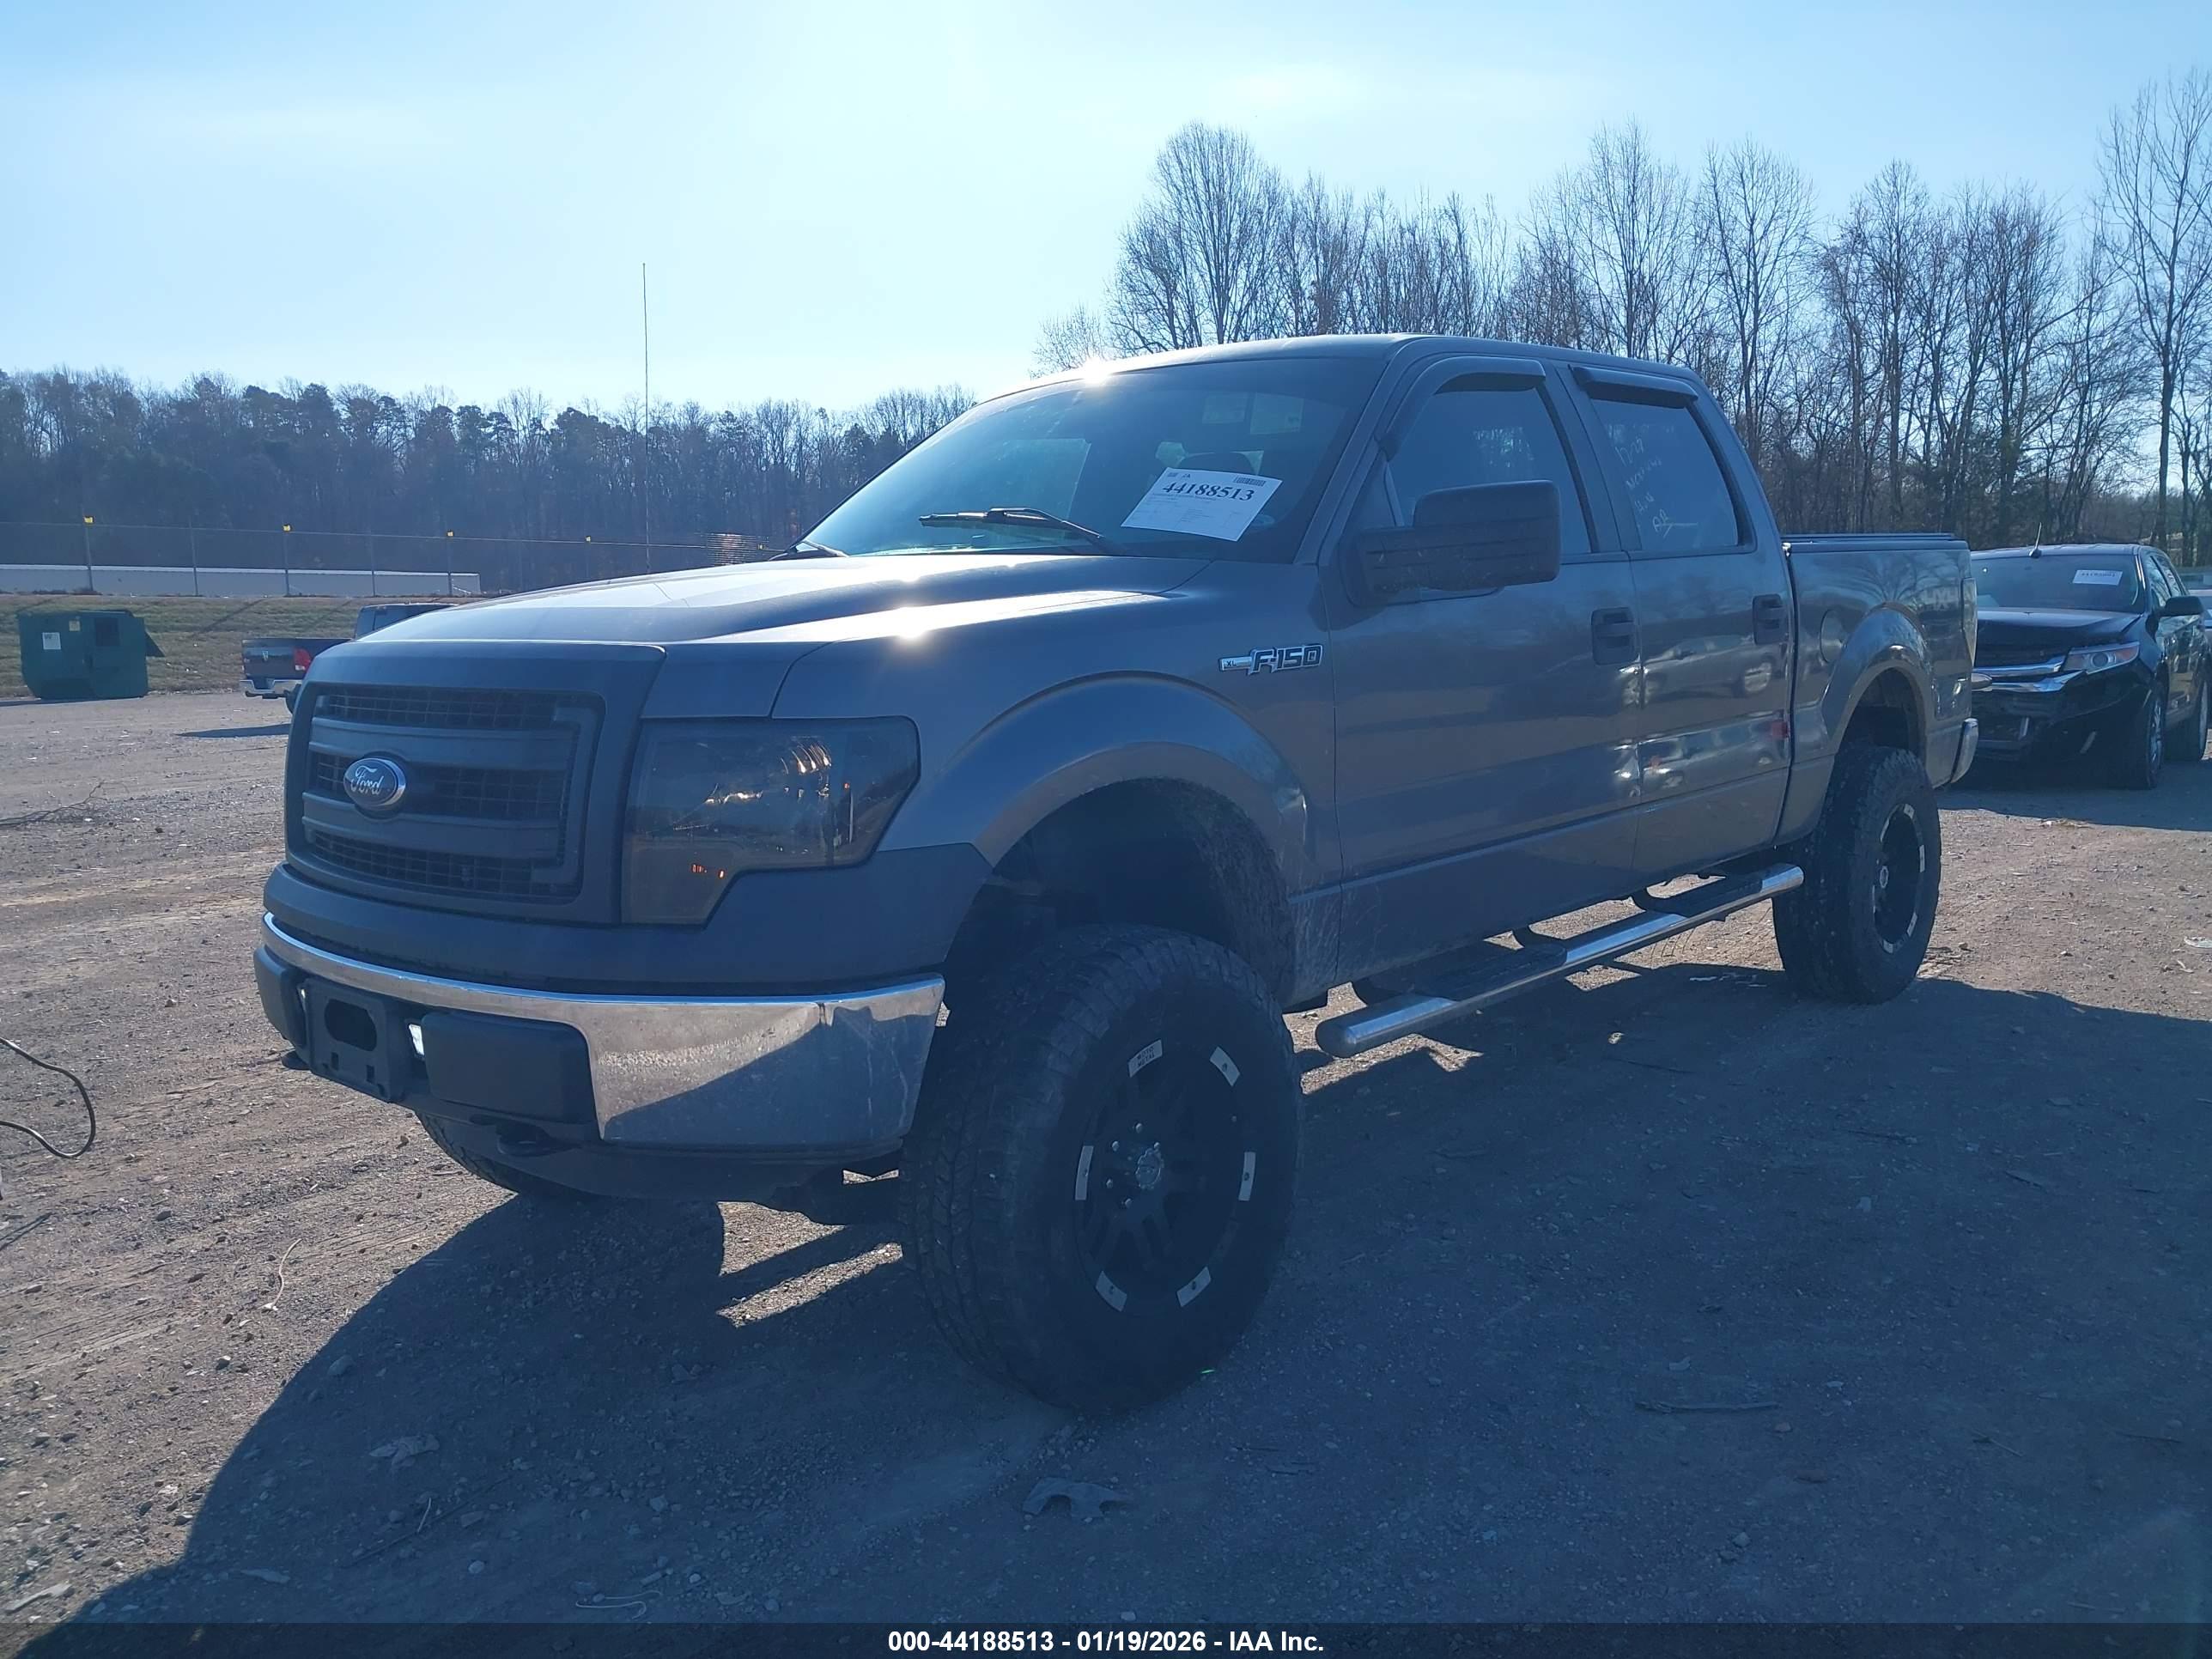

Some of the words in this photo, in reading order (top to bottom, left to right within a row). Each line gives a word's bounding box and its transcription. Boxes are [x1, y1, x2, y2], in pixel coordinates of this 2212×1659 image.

[1163, 482, 1255, 501] 44188513
[1248, 645, 1322, 675] F-150
[350, 765, 385, 795] Ford
